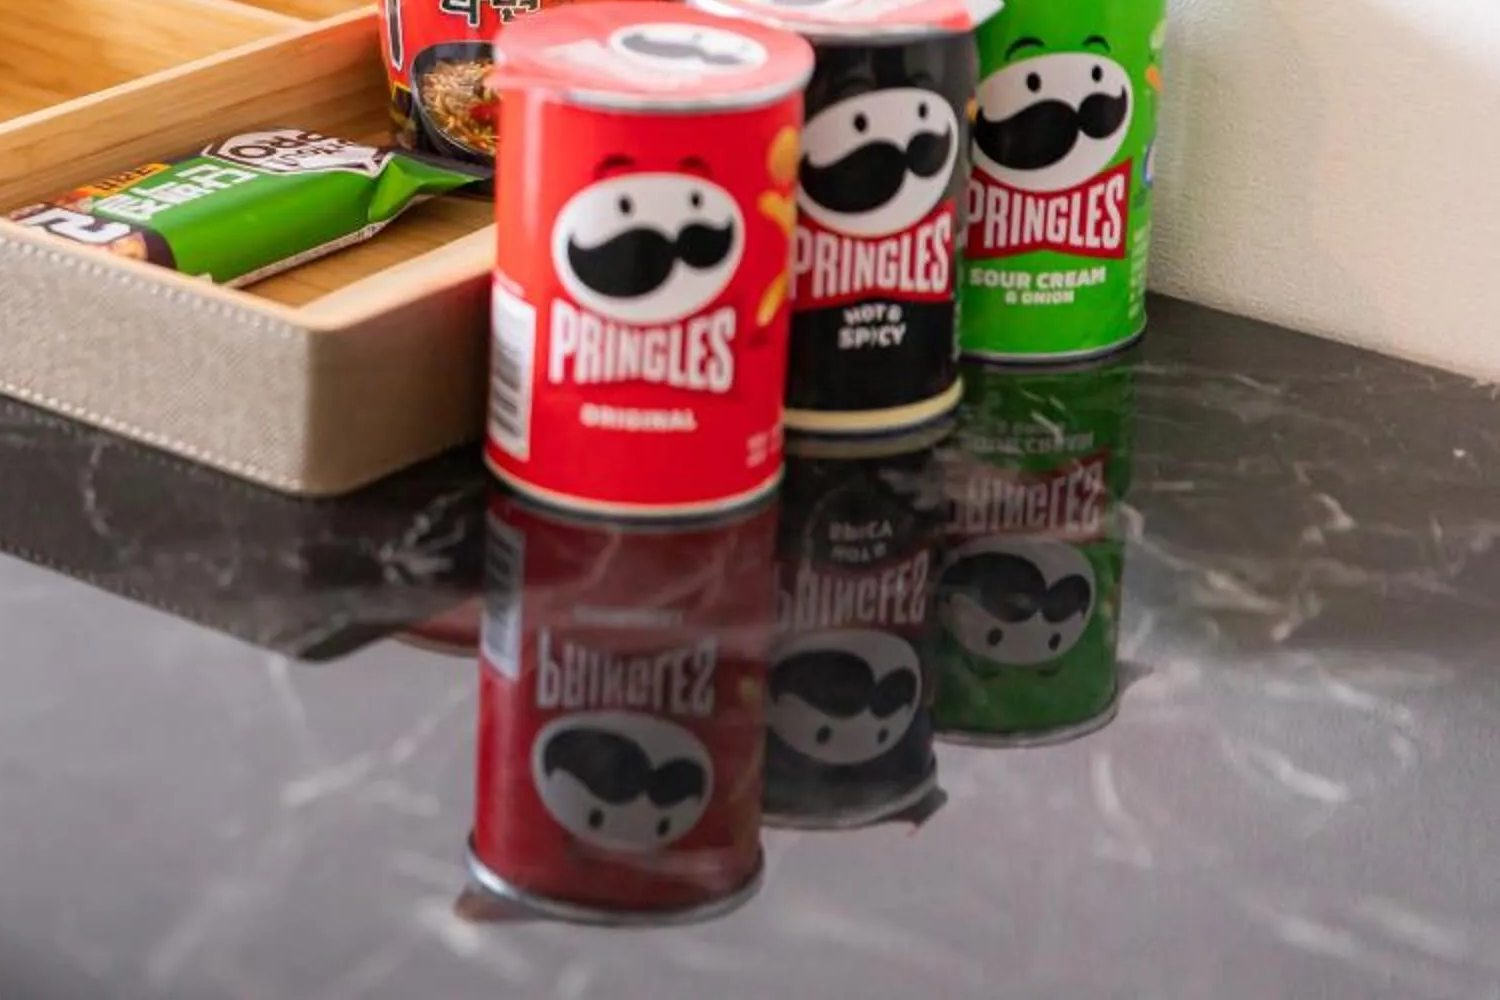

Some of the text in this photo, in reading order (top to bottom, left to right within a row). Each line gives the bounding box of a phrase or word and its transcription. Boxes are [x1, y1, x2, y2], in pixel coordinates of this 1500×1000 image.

[959, 173, 1125, 250] PRINGLES
[788, 212, 951, 300] PRINGLES
[969, 266, 1106, 289] SOUR CREAM
[844, 303, 886, 325] HOT
[549, 298, 736, 394] PRINGLES
[837, 323, 907, 349] SPICY
[579, 403, 698, 433] ORIGINAL
